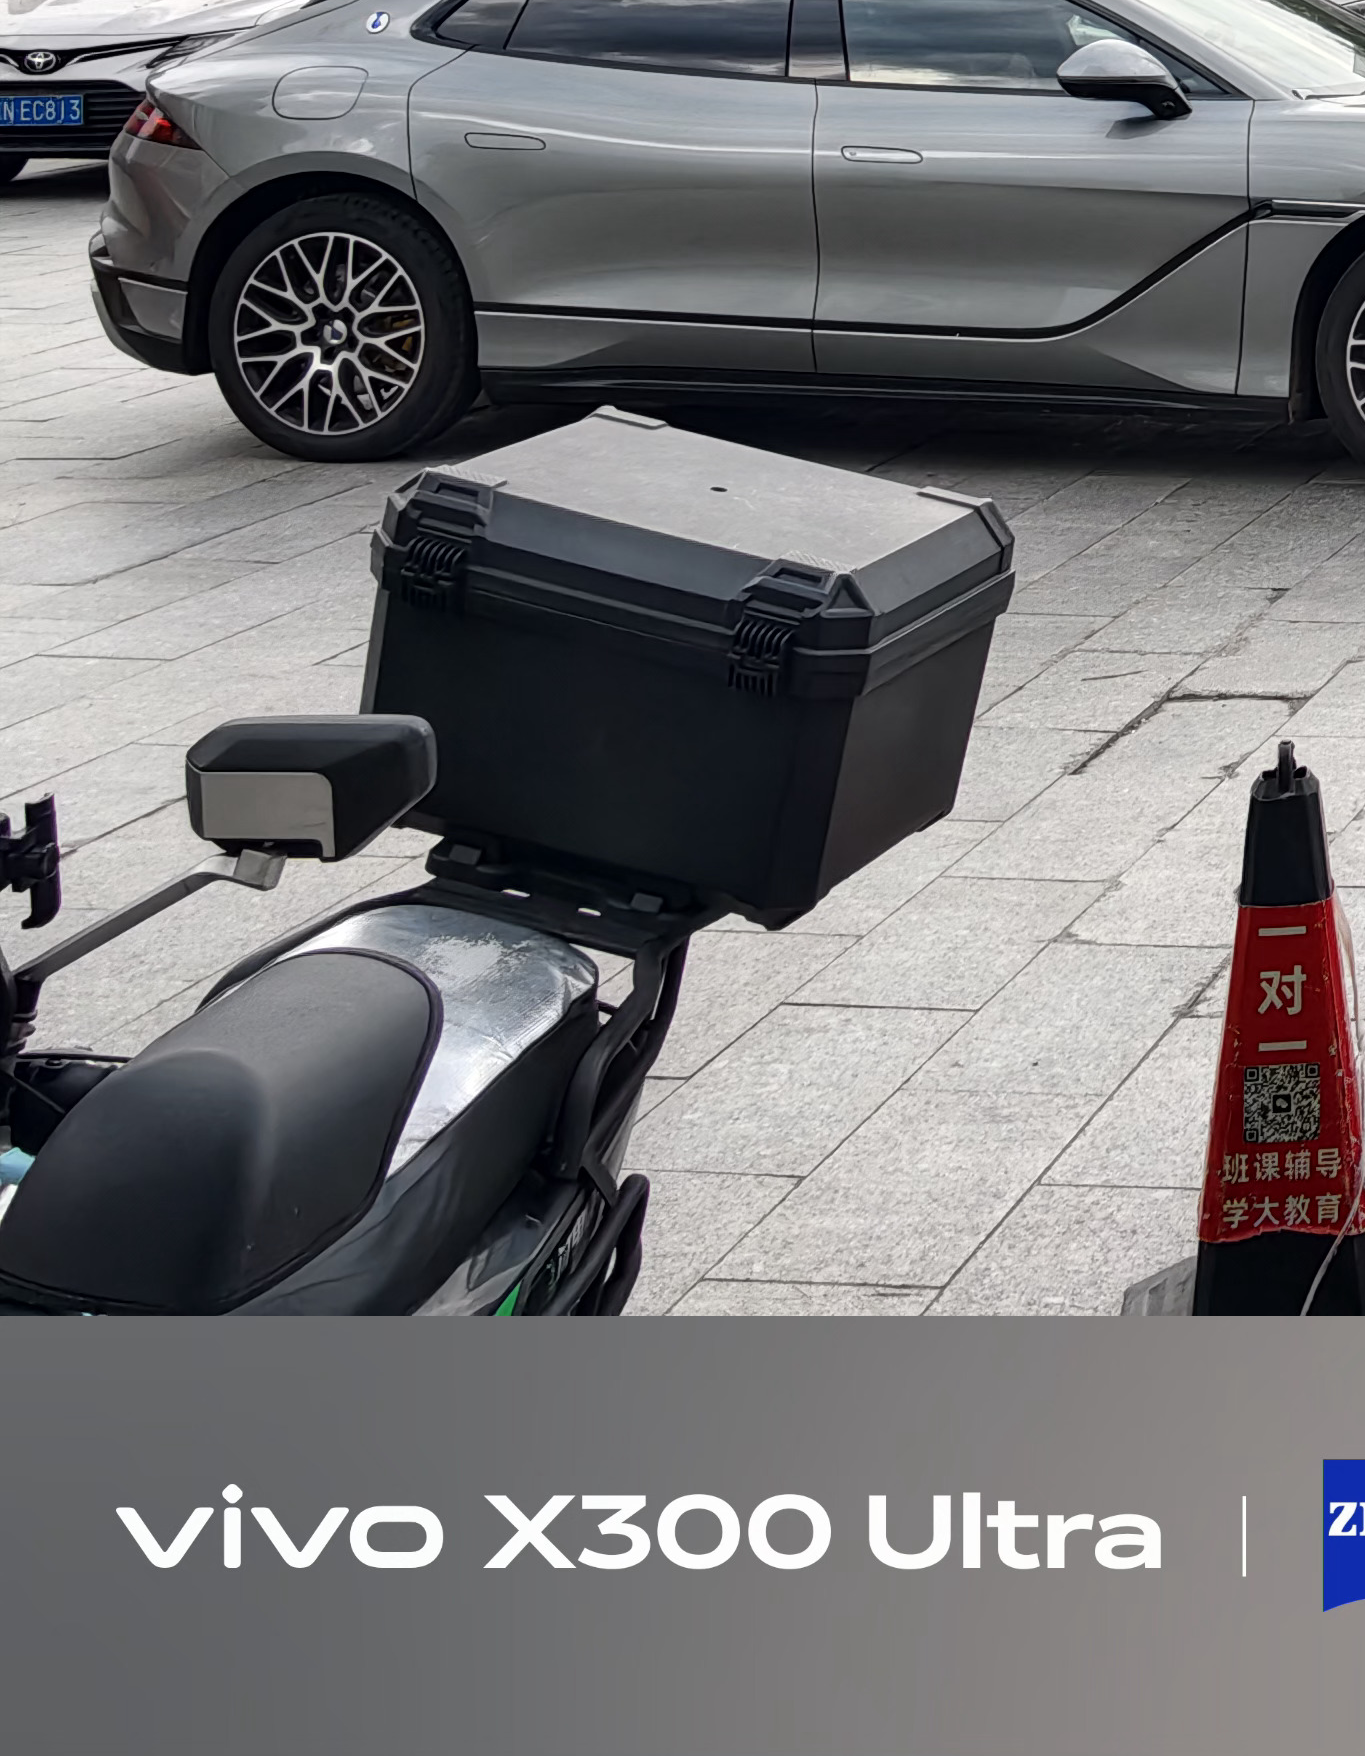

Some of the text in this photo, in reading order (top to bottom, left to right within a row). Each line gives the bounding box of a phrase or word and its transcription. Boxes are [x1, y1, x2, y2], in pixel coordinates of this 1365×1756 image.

[0, 99, 80, 122] NEC8J3
[1258, 925, 1307, 1052] 一对一
[1221, 1147, 1343, 1184] 班课辅导
[1221, 1193, 1342, 1230] 学大教育
